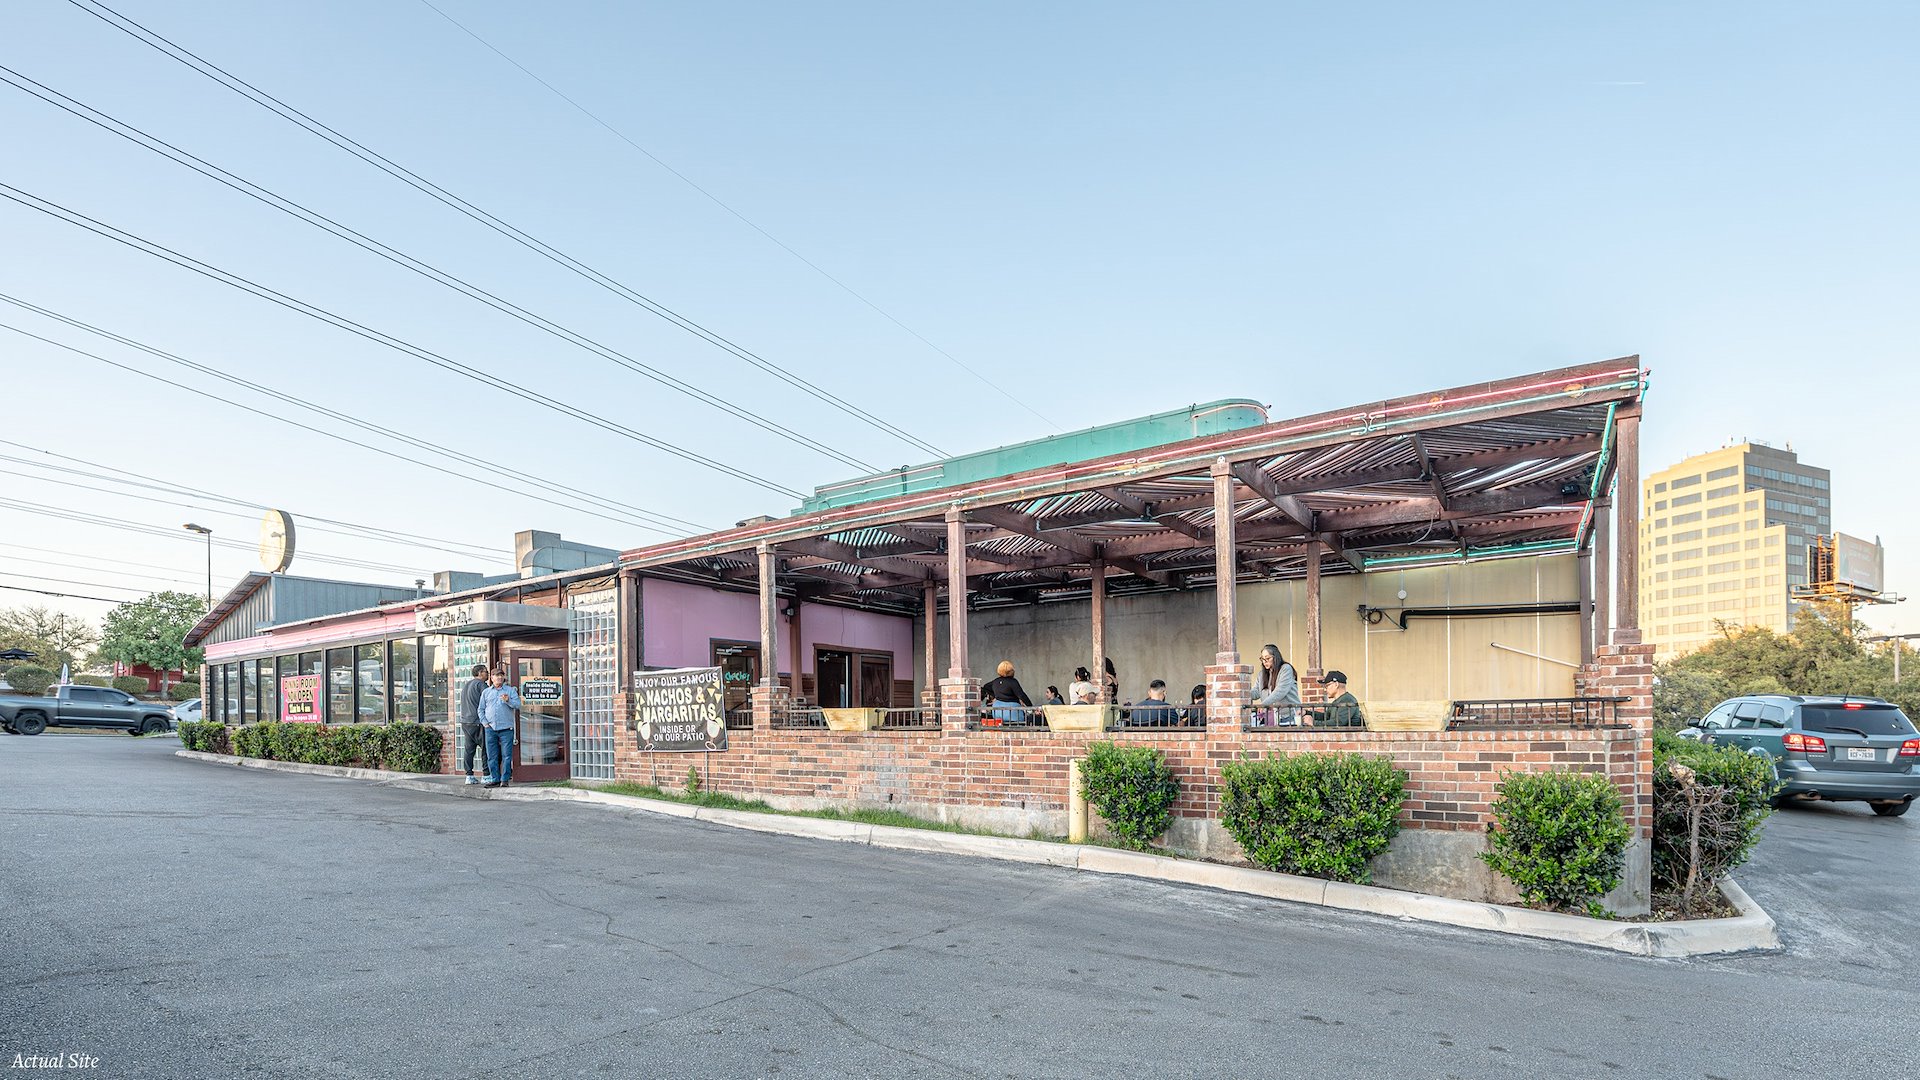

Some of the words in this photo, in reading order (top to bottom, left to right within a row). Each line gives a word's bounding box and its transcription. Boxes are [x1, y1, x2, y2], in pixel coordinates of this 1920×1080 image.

[301, 678, 318, 688] ROOM
[635, 677, 659, 688] ENJOY
[660, 676, 679, 687] OUR
[679, 672, 719, 685] FAMOUS
[298, 690, 314, 701] OPEN
[646, 686, 693, 706] NACHOS
[695, 686, 705, 704] &
[642, 703, 717, 723] MARGARITAS
[659, 725, 683, 734] INSIDE
[685, 724, 696, 733] OR
[653, 733, 664, 742] ON
[665, 733, 681, 741] OUR
[682, 732, 704, 741] PATIO
